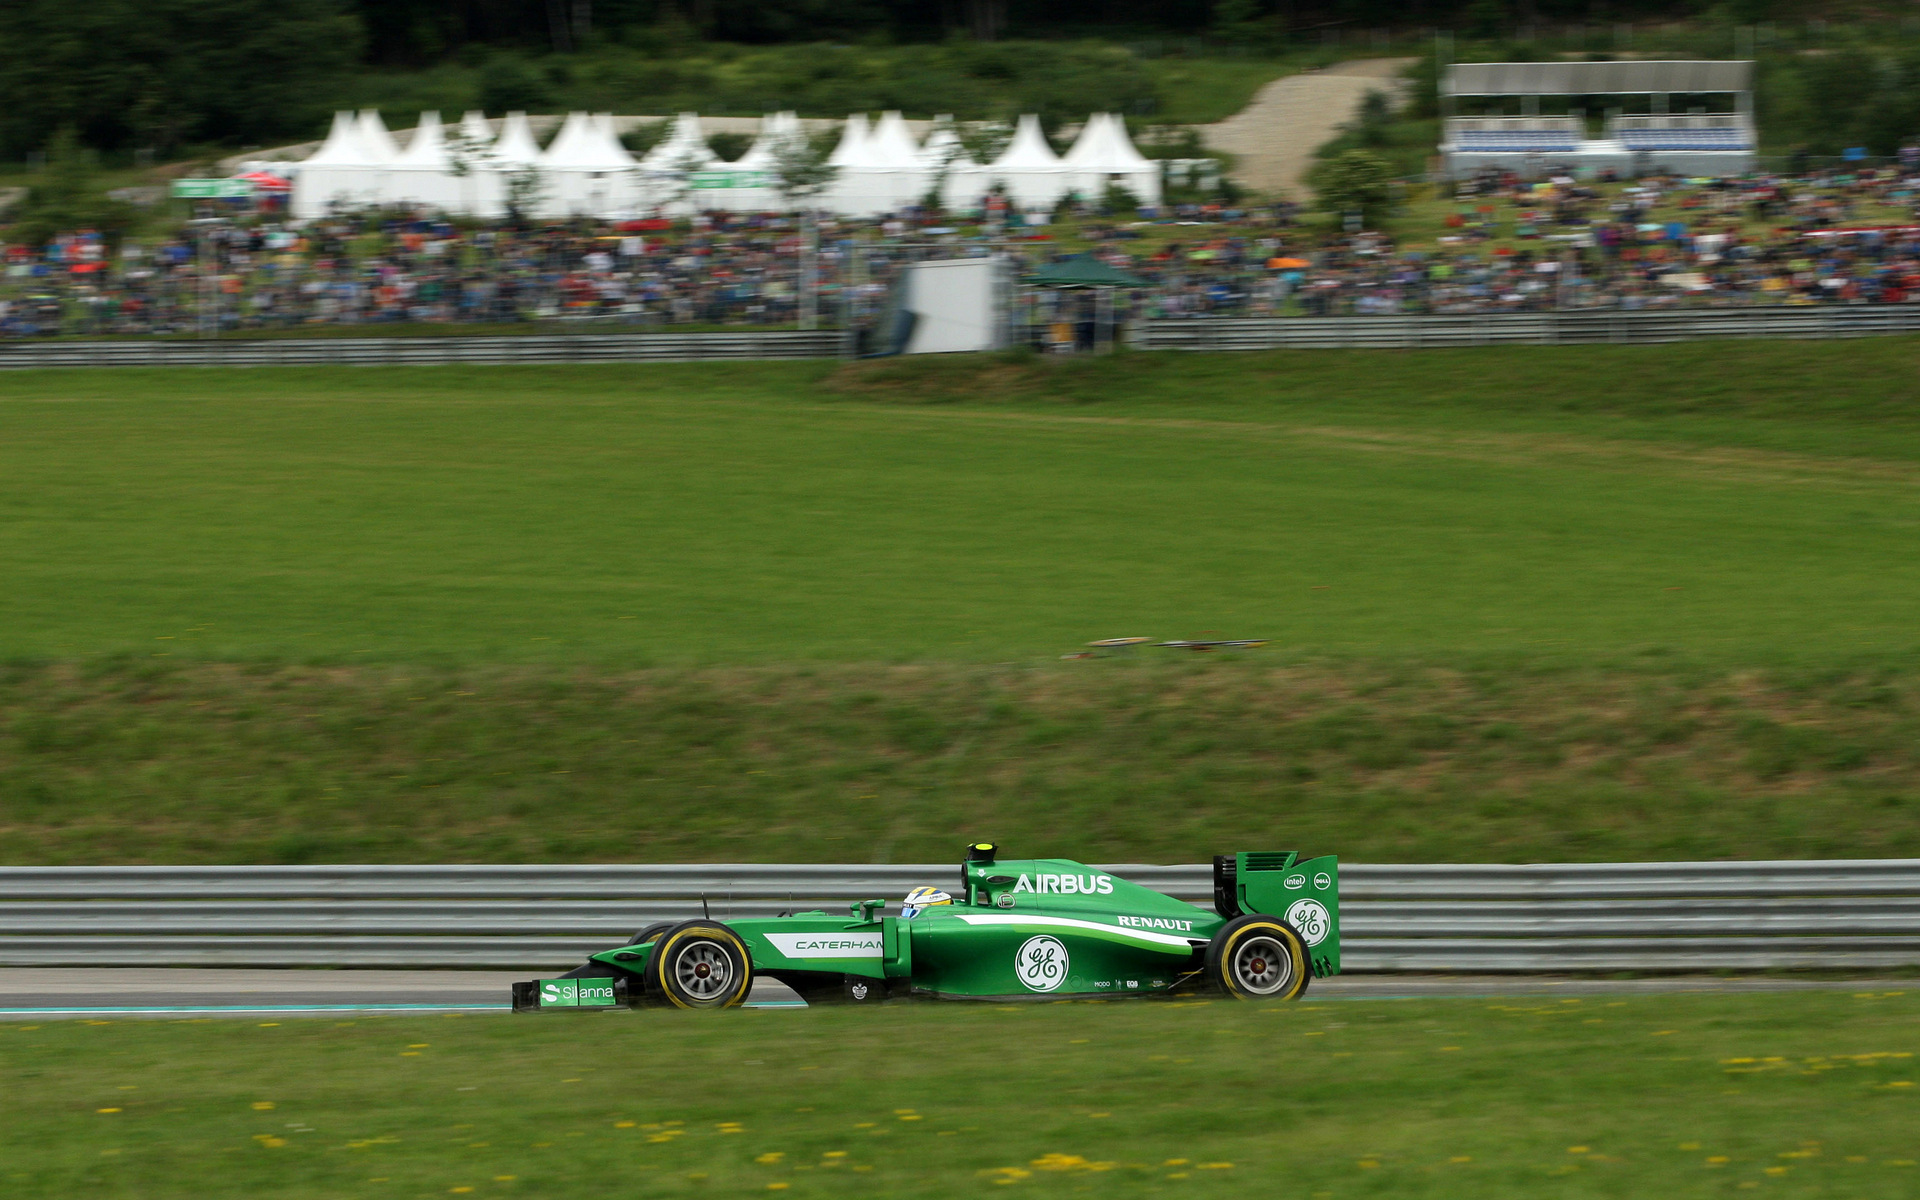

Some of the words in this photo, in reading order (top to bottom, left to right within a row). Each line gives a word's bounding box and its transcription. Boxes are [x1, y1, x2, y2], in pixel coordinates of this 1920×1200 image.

[1013, 873, 1114, 894] AIRBUS
[1286, 877, 1303, 886] intel
[1117, 915, 1192, 931] RENAULT
[1027, 948, 1057, 978] GE
[562, 985, 614, 999] Silanna
